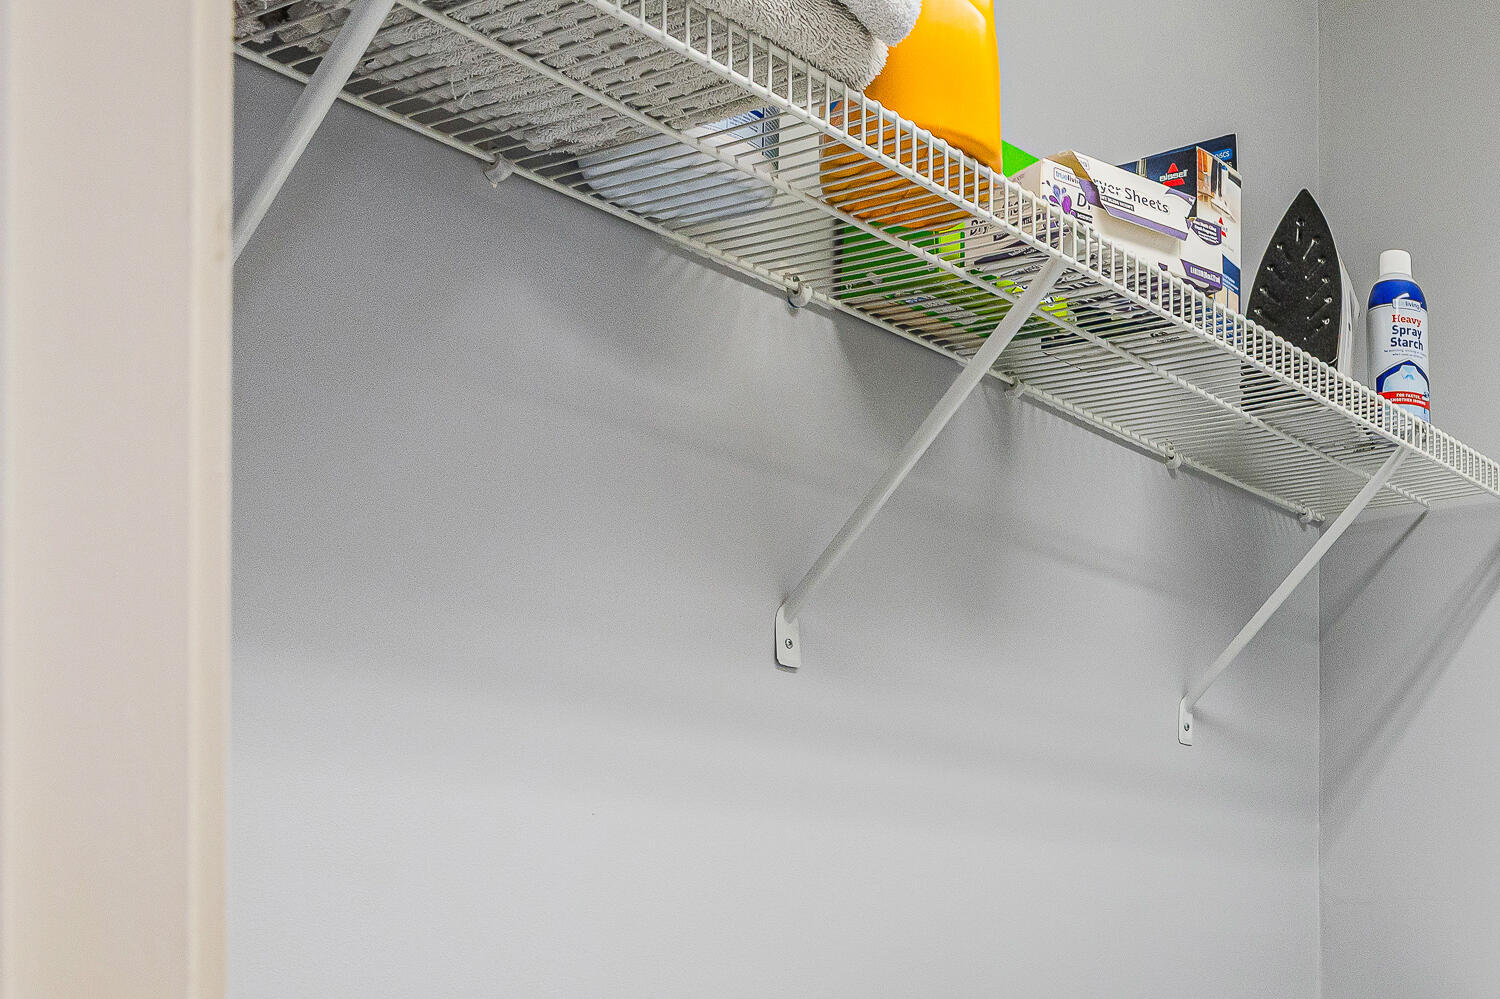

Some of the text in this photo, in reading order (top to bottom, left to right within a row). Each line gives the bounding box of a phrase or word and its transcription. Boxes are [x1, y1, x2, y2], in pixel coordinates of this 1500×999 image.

[1124, 186, 1169, 214] Sheets
[1391, 313, 1422, 328] Heavy
[1391, 324, 1422, 340] Spray
[1390, 336, 1424, 351] Starch
